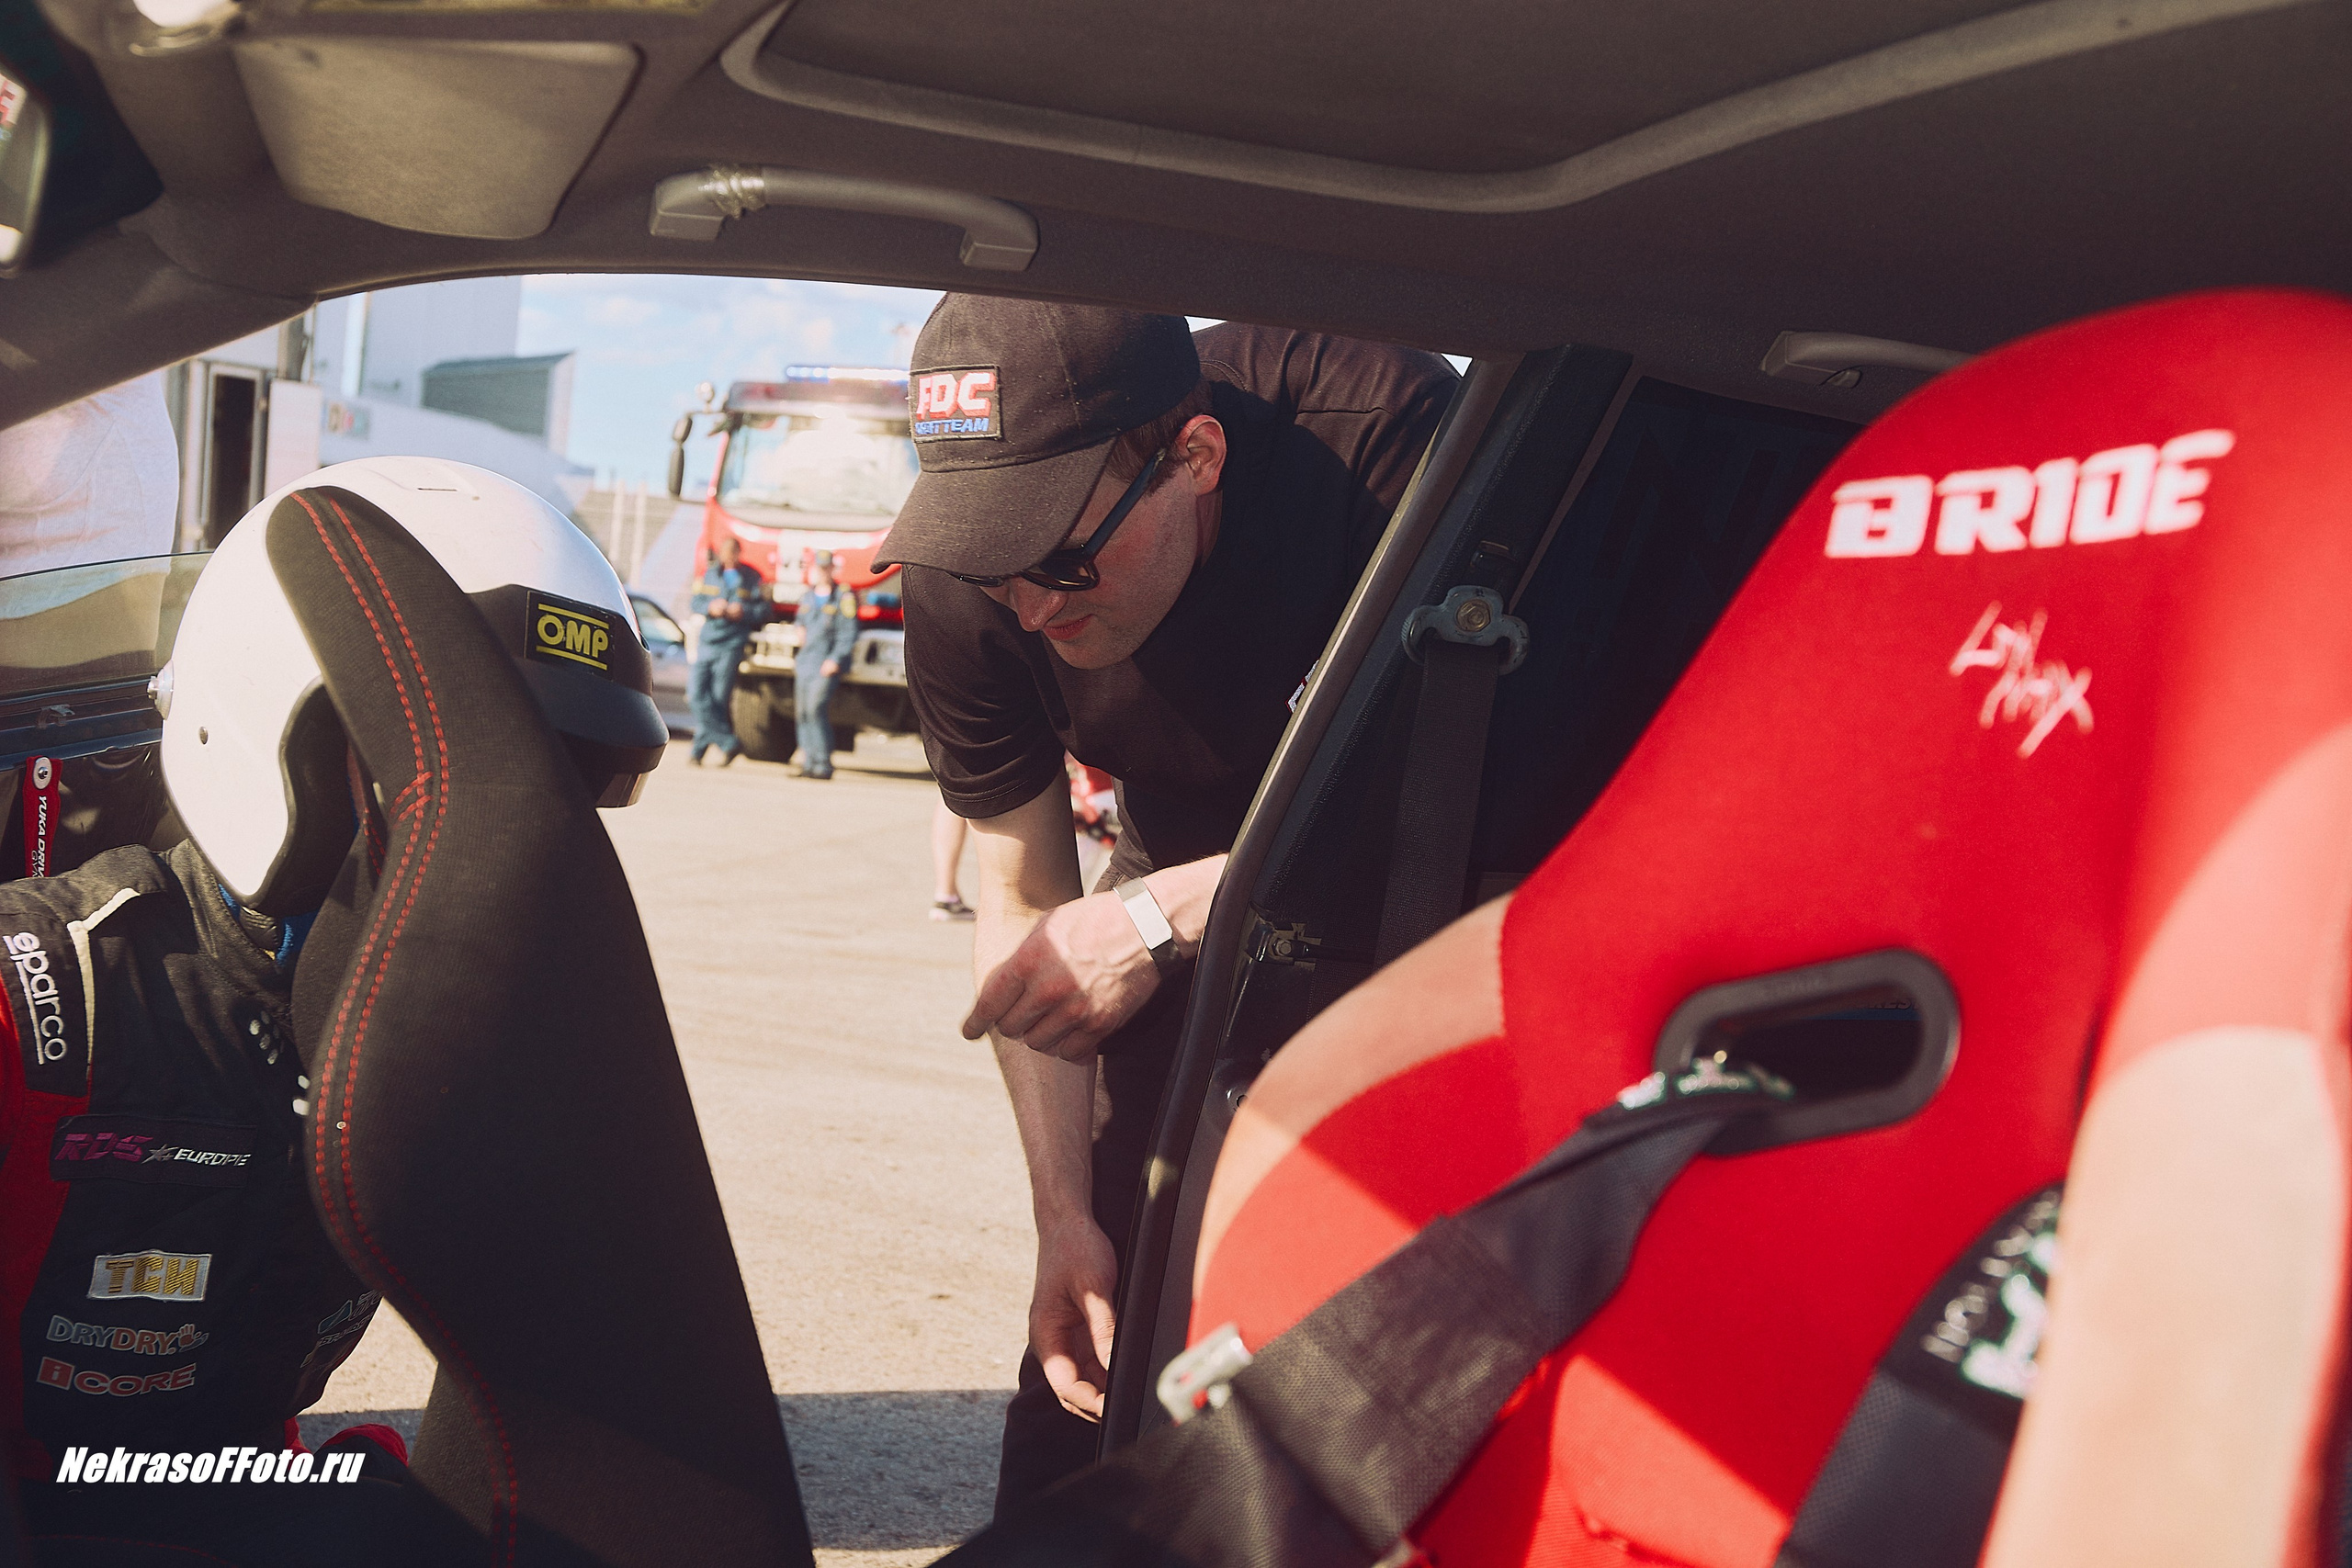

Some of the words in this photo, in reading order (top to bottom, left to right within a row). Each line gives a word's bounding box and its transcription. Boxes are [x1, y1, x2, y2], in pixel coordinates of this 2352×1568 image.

[916, 371, 997, 420] FDC
[1824, 428, 2236, 558] BRIDE
[537, 614, 609, 658] OMP
[38, 795, 47, 836] YUKA
[37, 837, 46, 877] DRIV
[6, 931, 68, 1062] sparco
[54, 1132, 153, 1163] RDS
[174, 1148, 251, 1168] EUROPE
